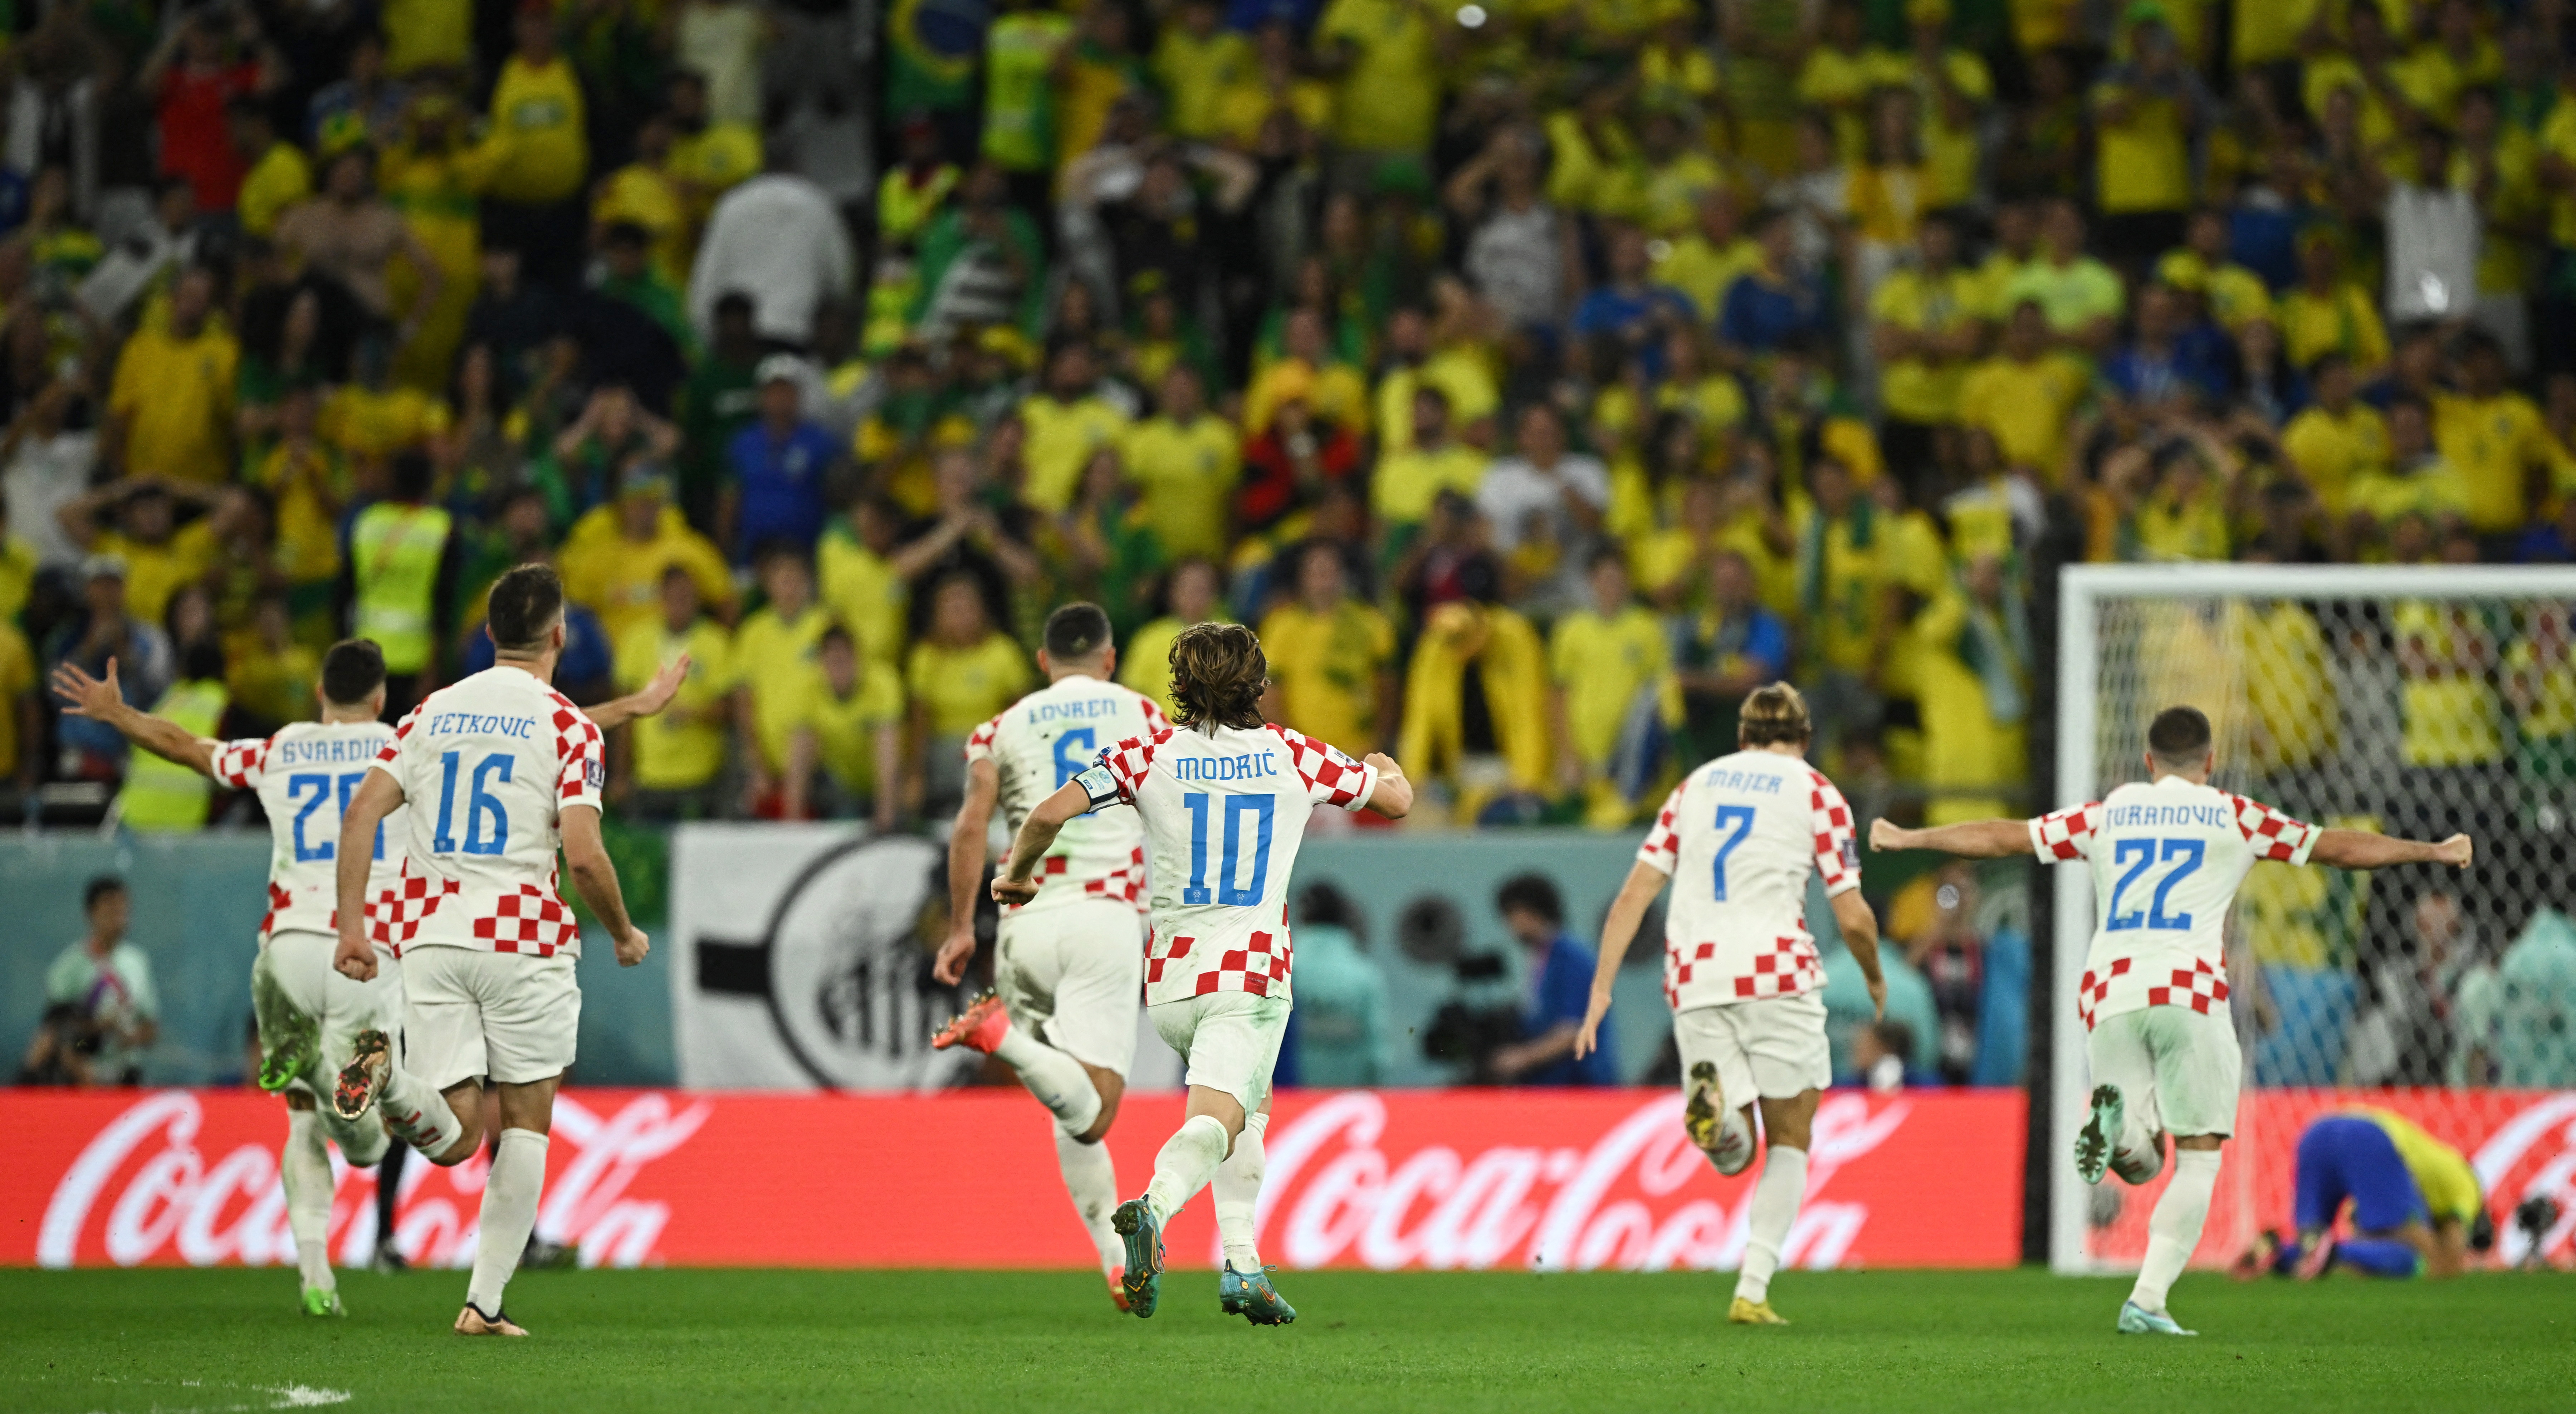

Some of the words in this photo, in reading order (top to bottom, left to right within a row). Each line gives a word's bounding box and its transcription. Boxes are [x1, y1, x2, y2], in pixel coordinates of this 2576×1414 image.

[429, 713, 536, 739] PETKOVIĆ
[1029, 698, 1116, 724] LOVREN
[283, 737, 385, 763] GVARDIO
[1054, 727, 1098, 817] 6
[1176, 748, 1277, 780] MODRIĆ
[433, 751, 515, 855] 16
[1084, 780, 1092, 789] FIFA
[1707, 769, 1783, 794] MAJER
[2105, 805, 2227, 833] JURANOVIĆ
[1183, 793, 1275, 907] 10
[1713, 805, 1756, 902] 7
[2106, 838, 2205, 932] 22
[36, 1089, 712, 1269] CocaCla
[1211, 1089, 1914, 1271] Coca-Cola
